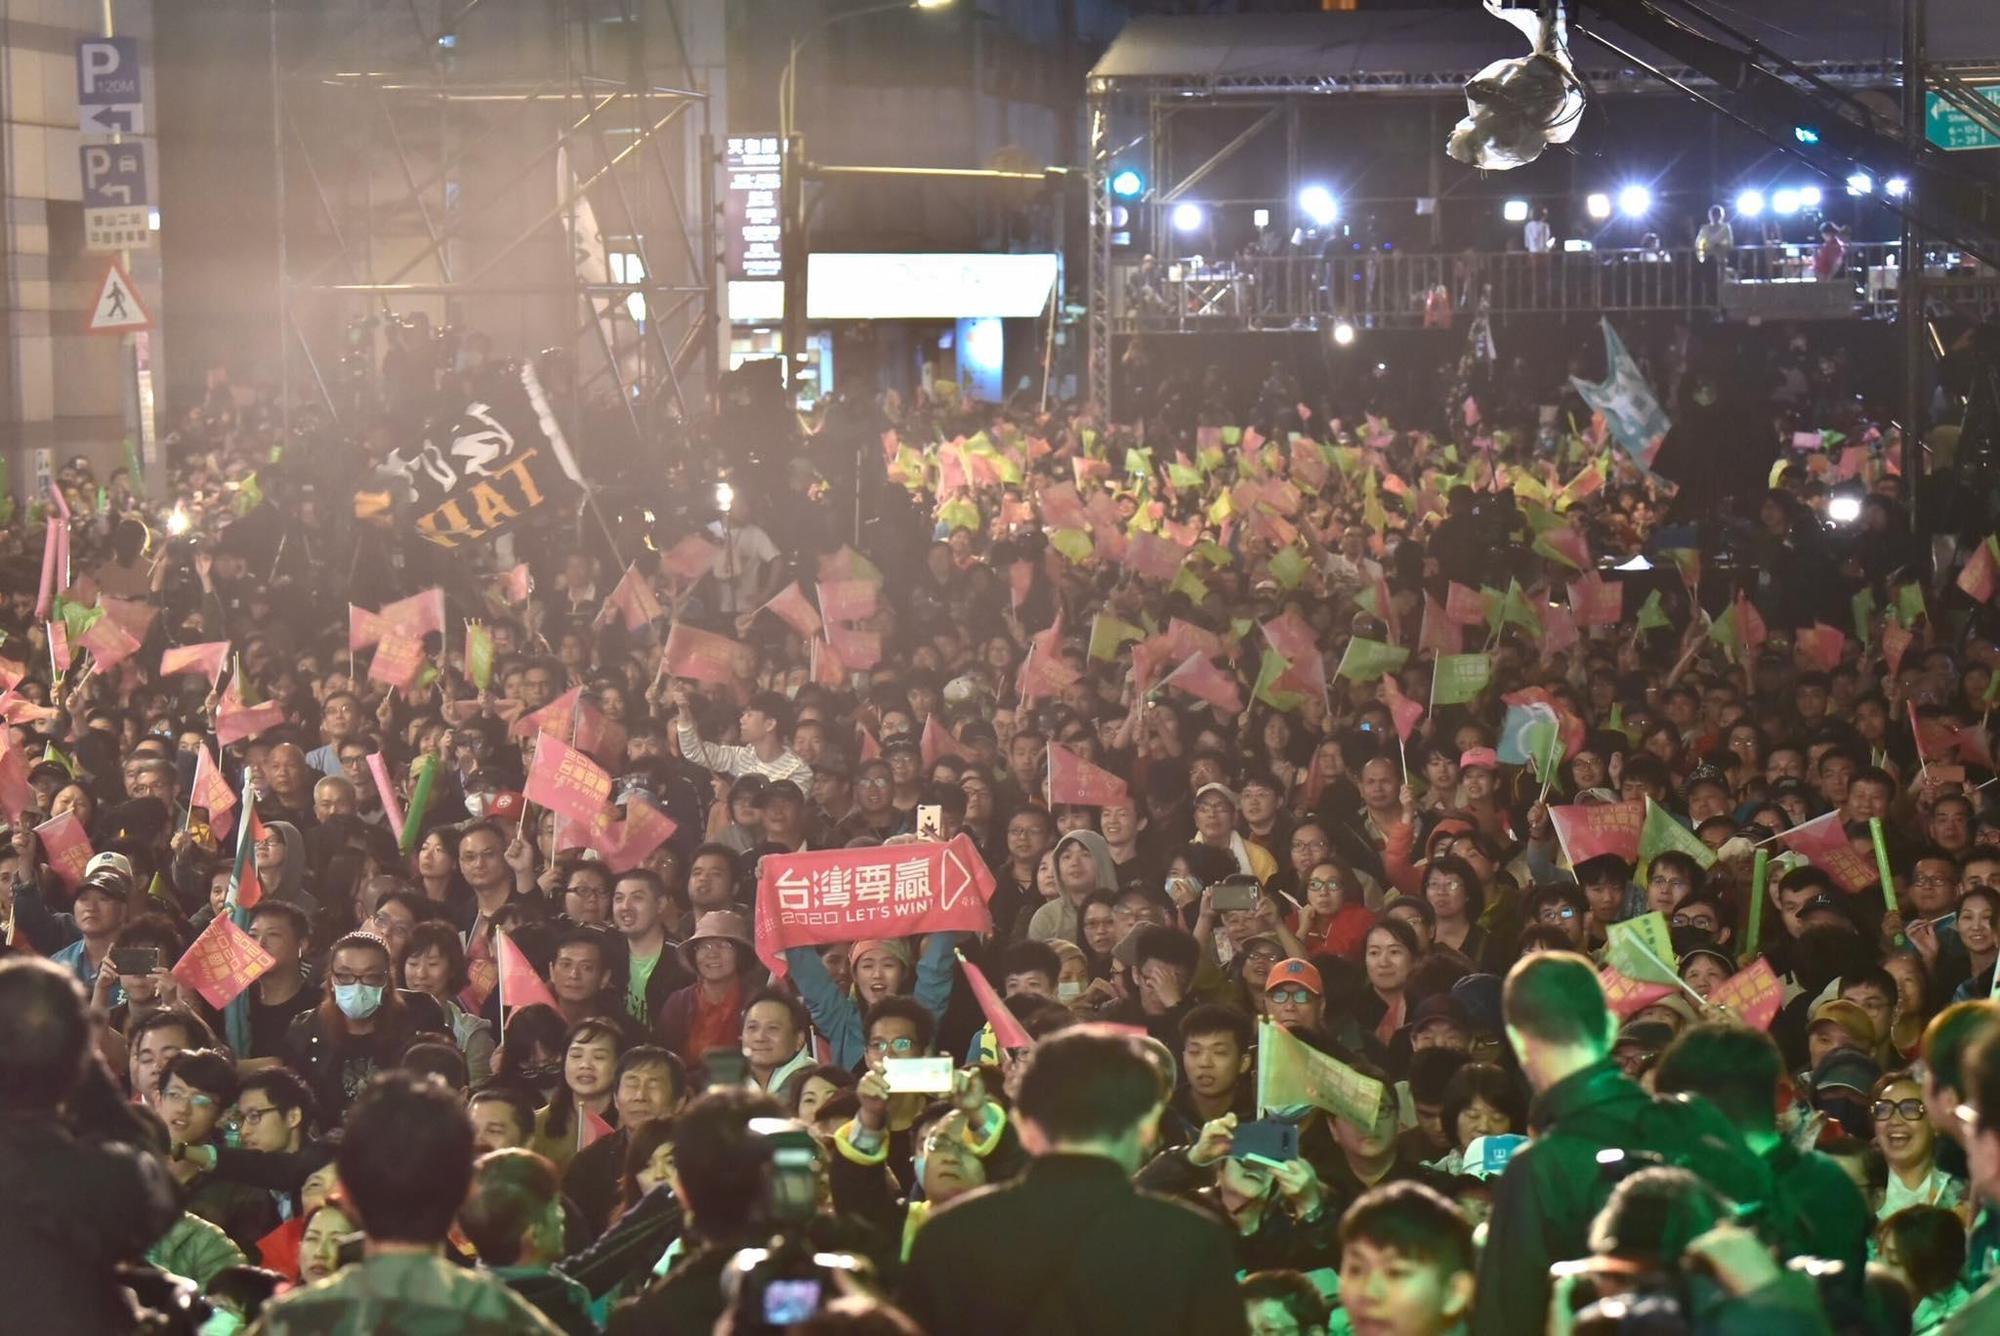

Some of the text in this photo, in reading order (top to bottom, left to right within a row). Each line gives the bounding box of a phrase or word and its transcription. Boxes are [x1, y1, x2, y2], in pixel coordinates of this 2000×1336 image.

[82, 43, 120, 94] P
[87, 148, 111, 190] P
[775, 857, 933, 910] 台灣要贏
[781, 911, 838, 925] 2020
[846, 906, 890, 922] LET'S
